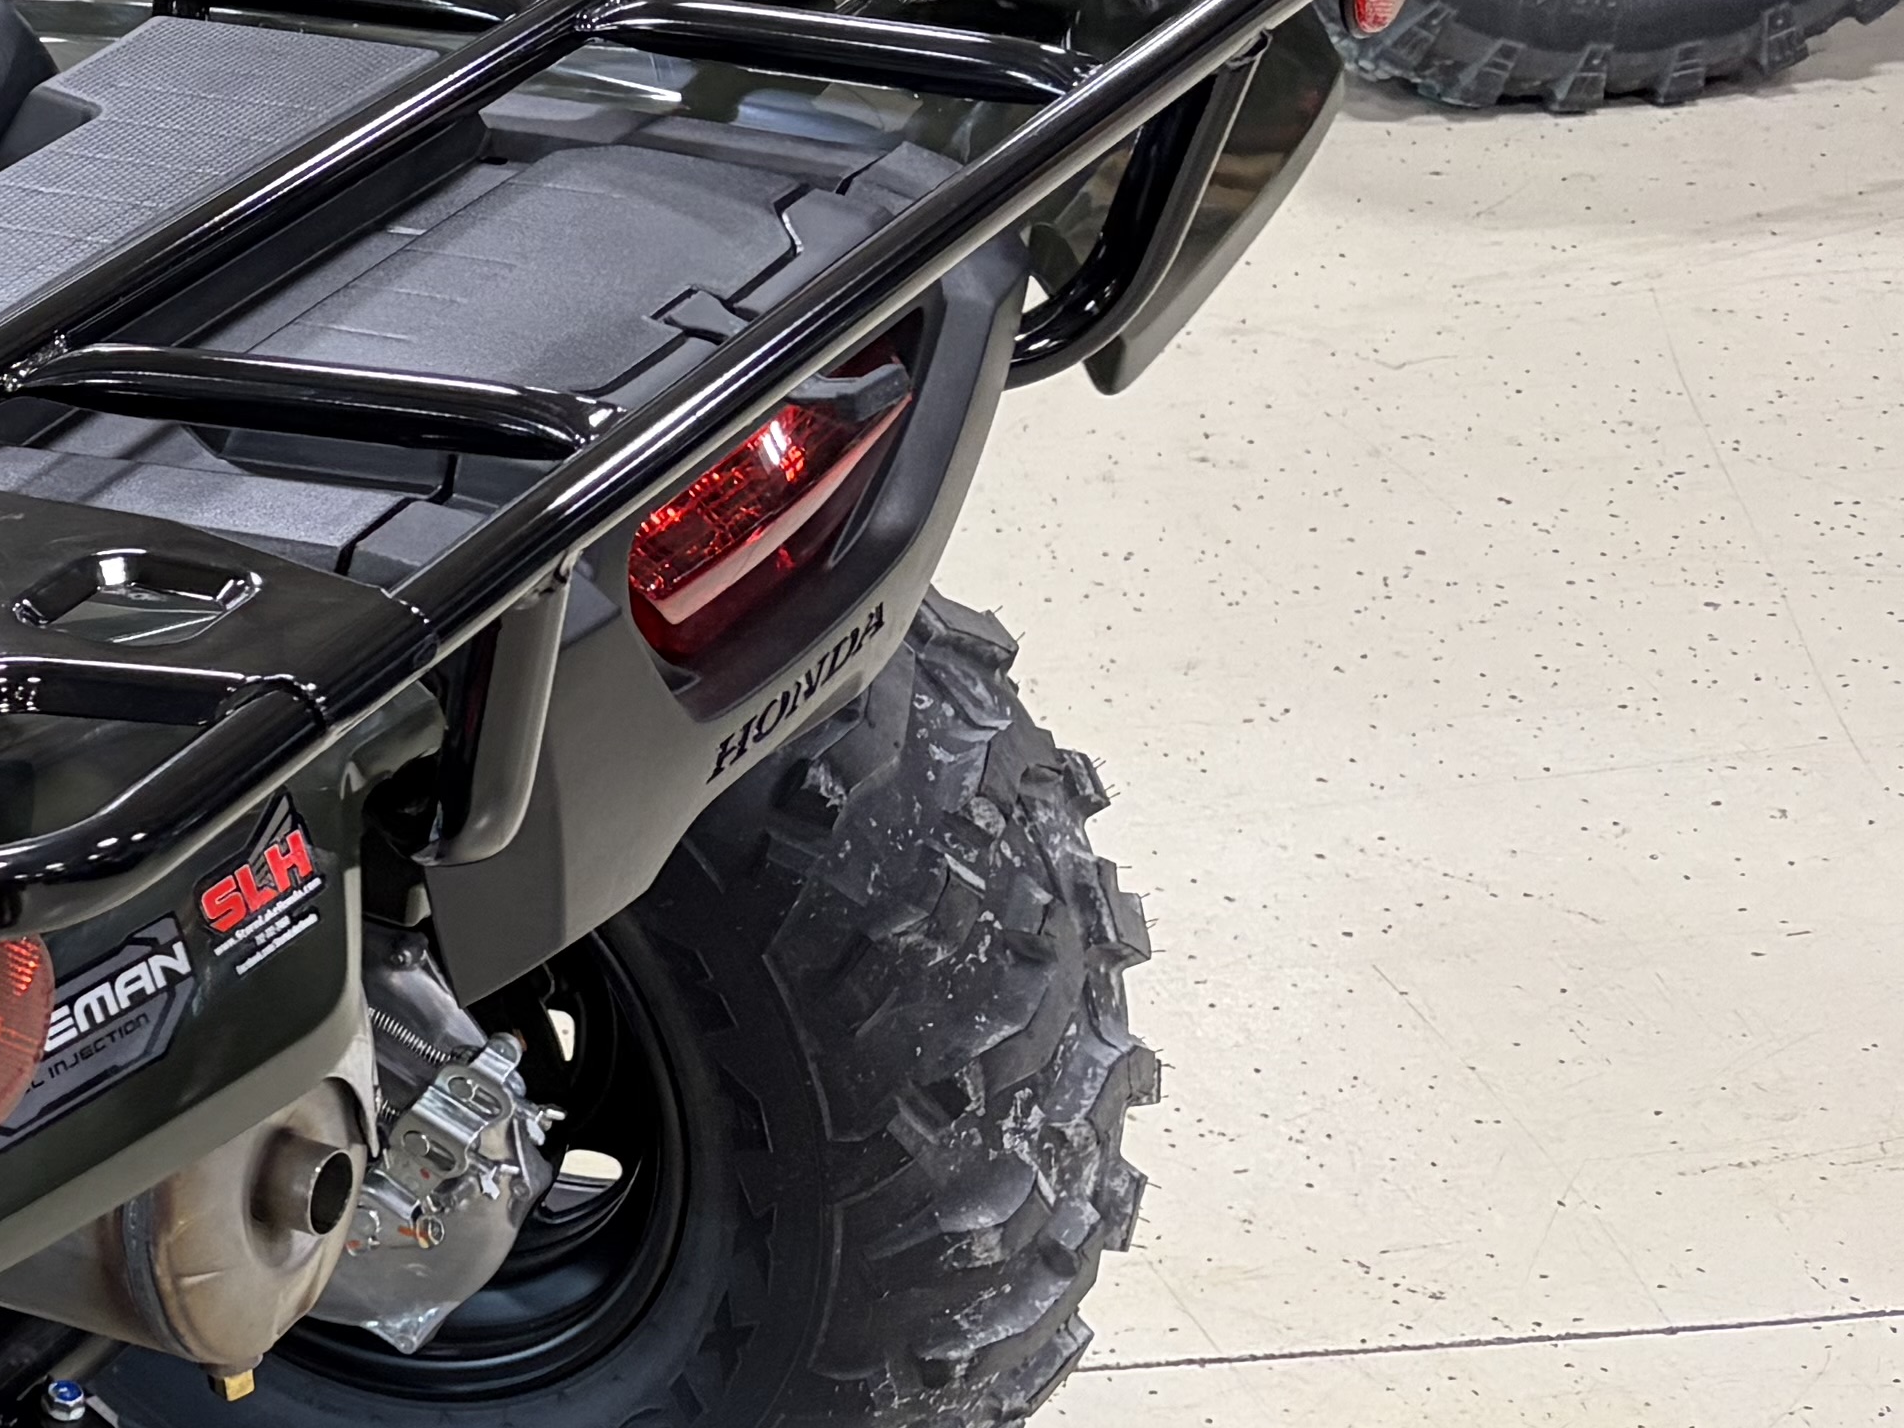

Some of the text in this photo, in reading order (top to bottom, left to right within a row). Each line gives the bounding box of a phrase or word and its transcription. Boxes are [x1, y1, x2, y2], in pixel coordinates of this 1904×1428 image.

[705, 601, 885, 785] HONDA
[201, 828, 314, 933] SLH
[43, 941, 192, 1053] EMAN
[49, 1013, 149, 1079] INJECTION
